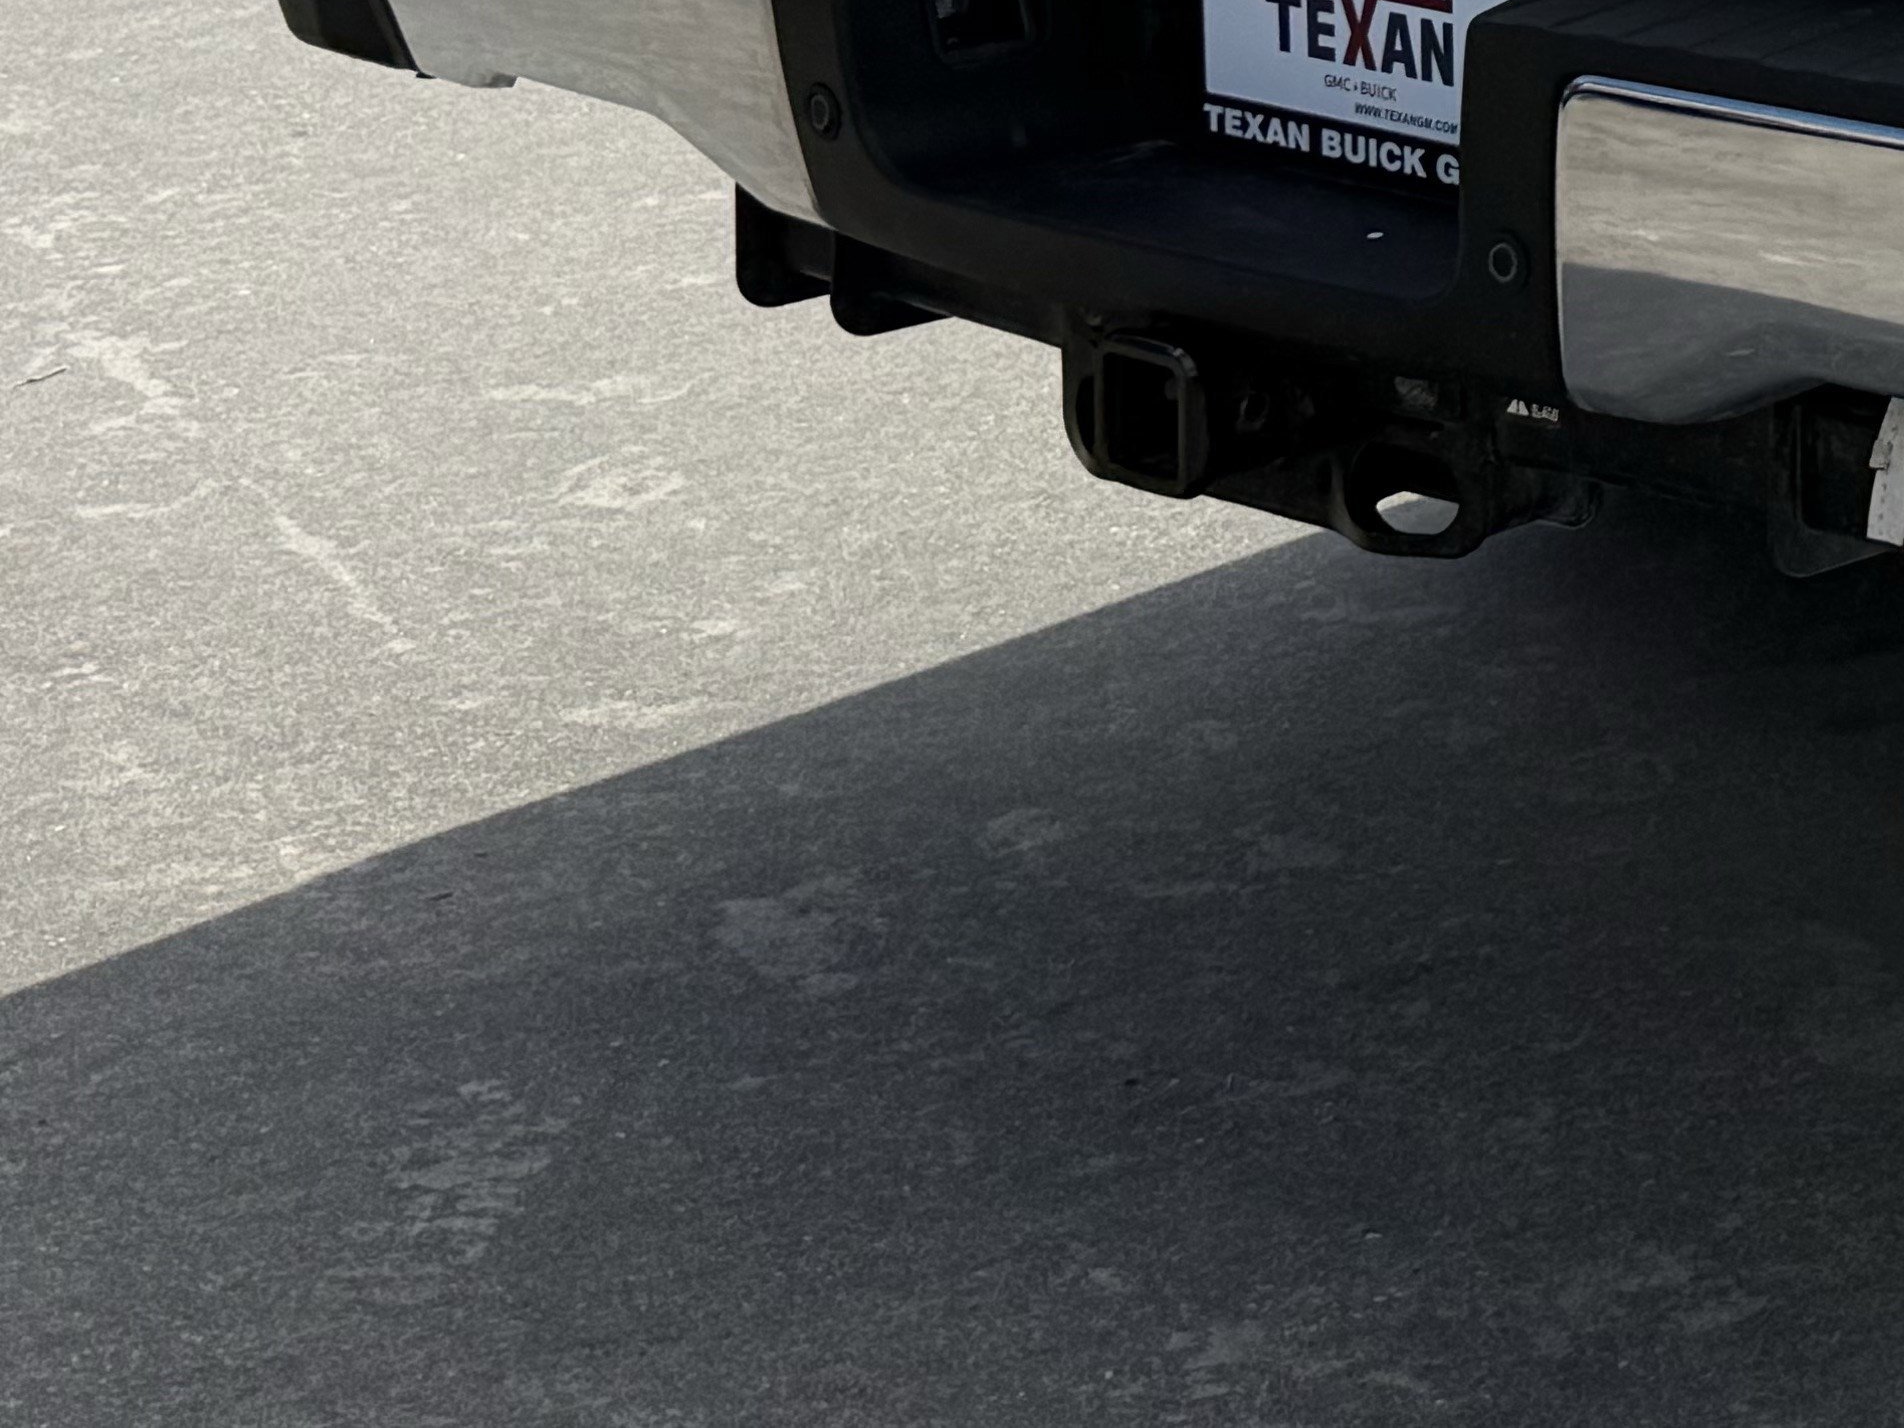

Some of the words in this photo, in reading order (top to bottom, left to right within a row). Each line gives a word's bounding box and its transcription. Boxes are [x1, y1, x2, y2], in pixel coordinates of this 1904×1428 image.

[1323, 73, 1352, 92] GMC
[1360, 80, 1397, 102] BUICK
[1203, 103, 1310, 152] TEXAN
[1321, 129, 1427, 179] BUICK
